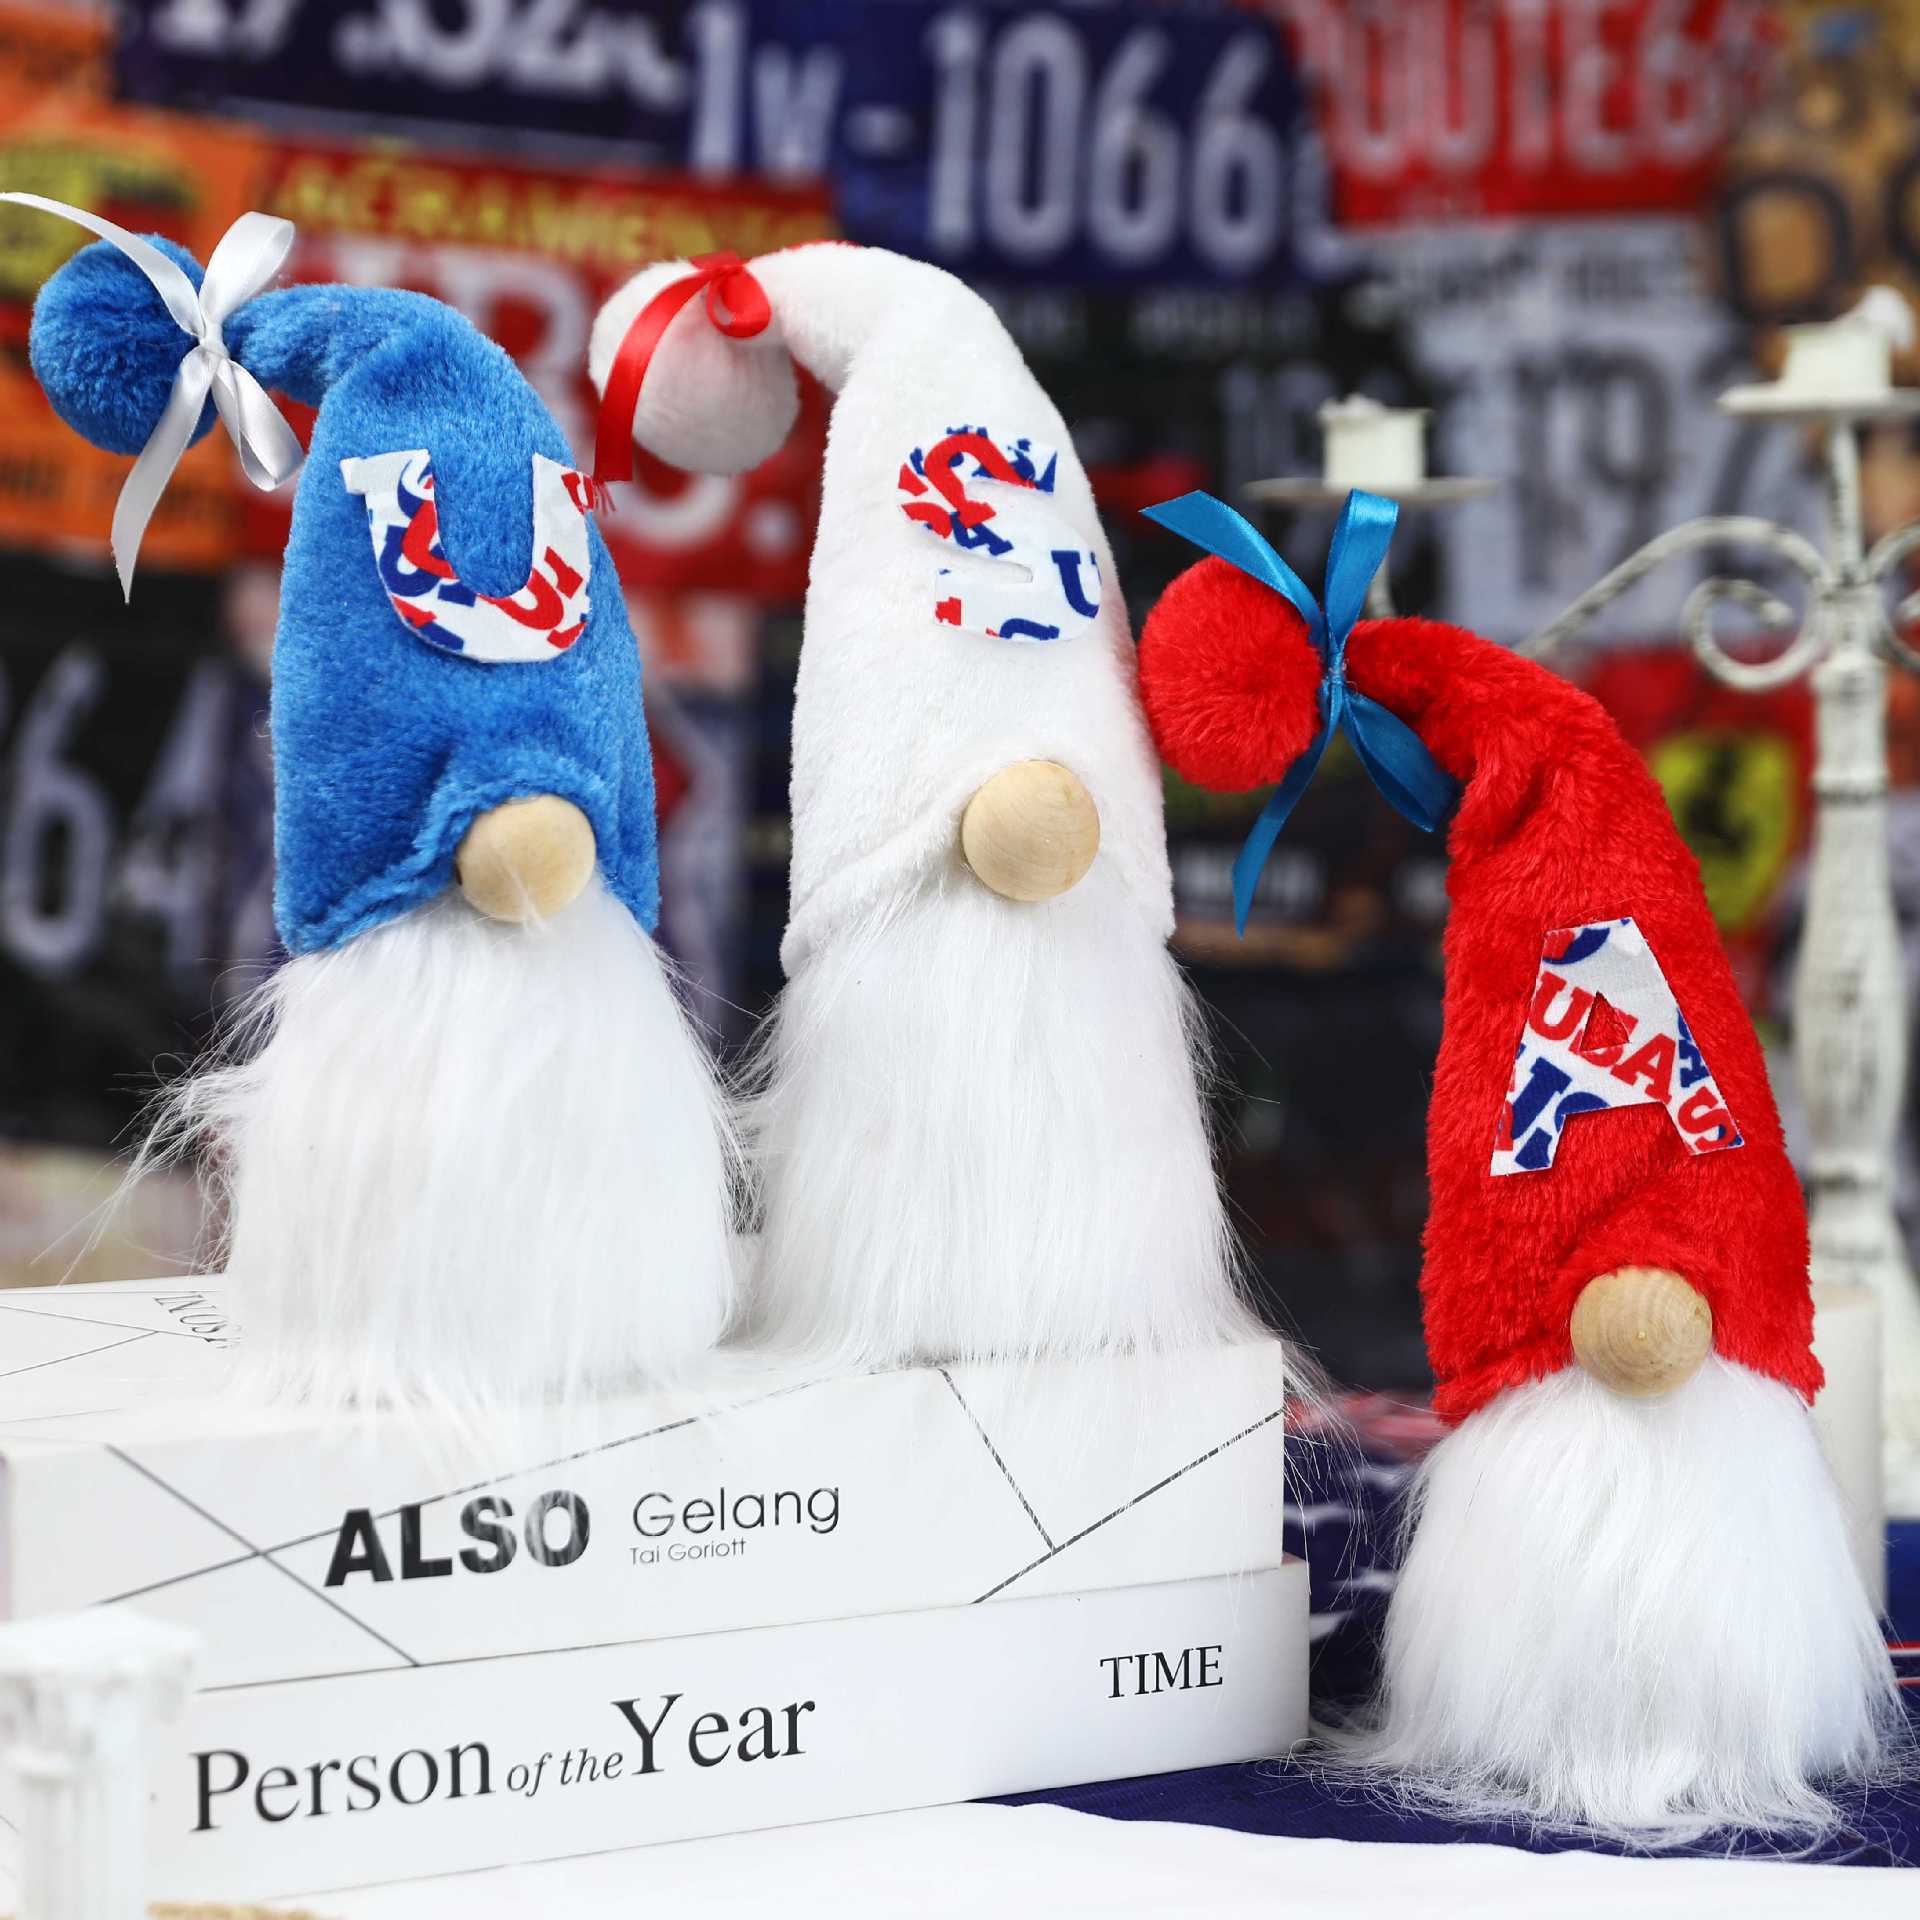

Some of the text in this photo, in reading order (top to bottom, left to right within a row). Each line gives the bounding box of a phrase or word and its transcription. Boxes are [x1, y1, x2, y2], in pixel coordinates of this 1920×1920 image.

[340, 448, 600, 664] U
[897, 424, 1103, 643] S
[1490, 916, 1745, 1177] A
[324, 1489, 591, 1588] ALSO
[629, 1538, 747, 1566] Tai Goriott
[632, 1486, 840, 1537] Gelang
[1099, 1644, 1224, 1699] TIME
[189, 1692, 816, 1834] Person of the Year
